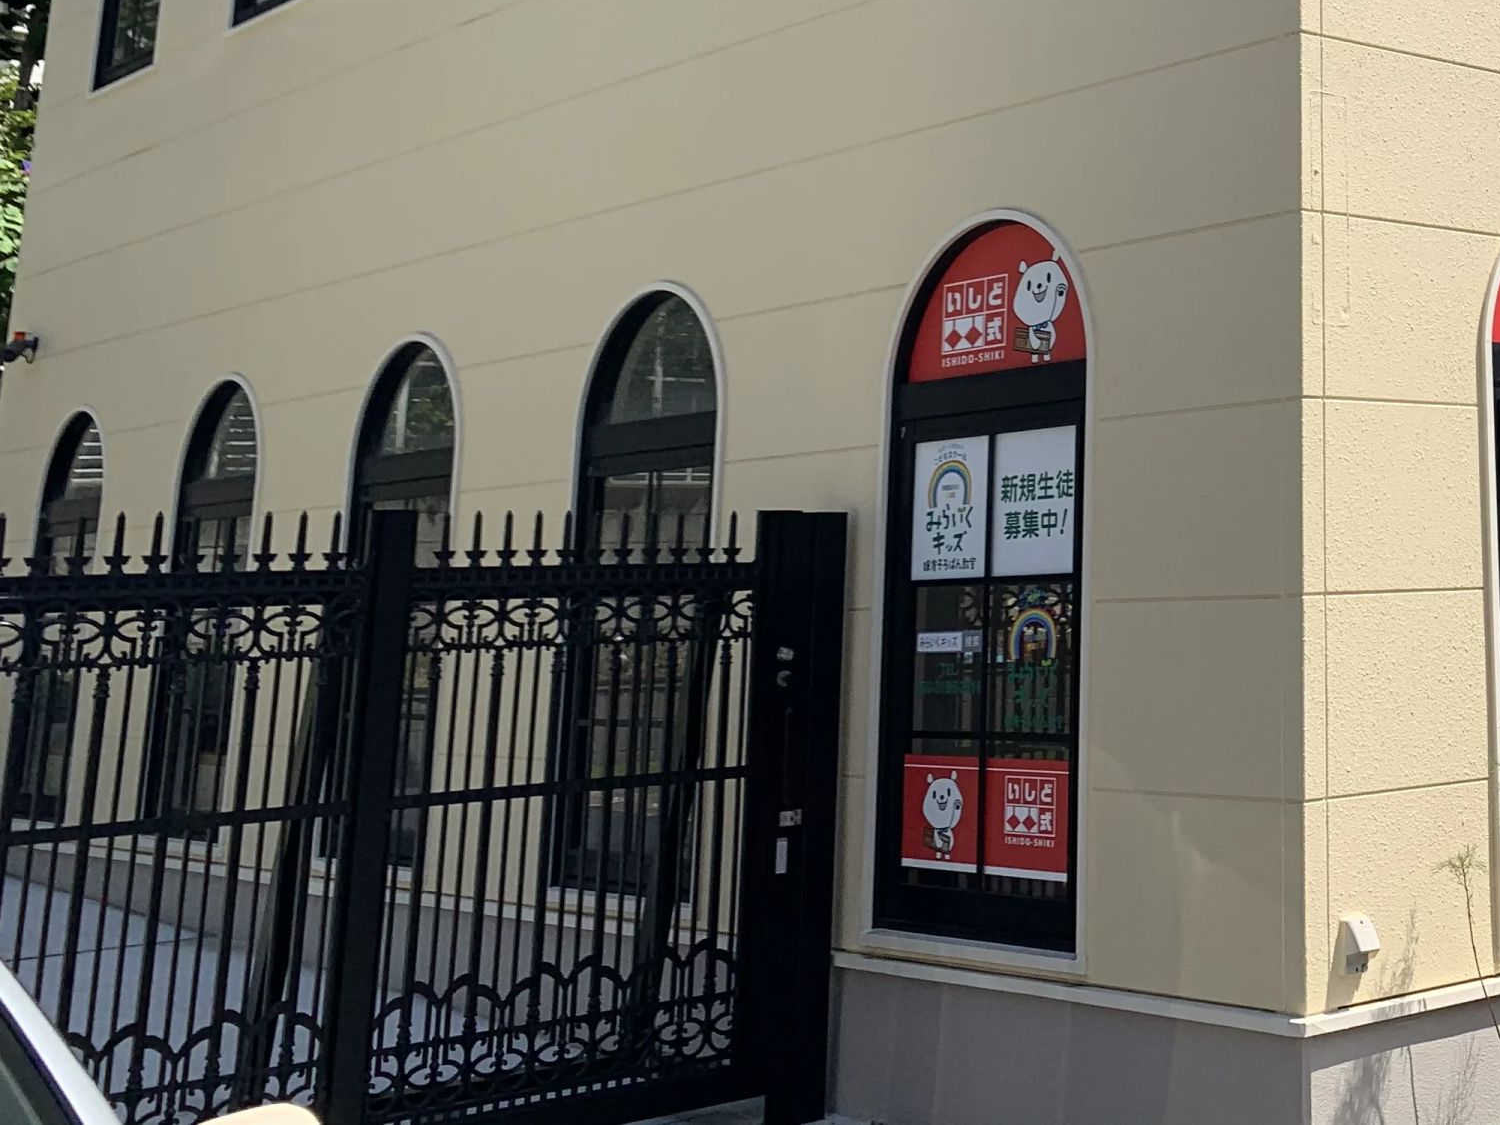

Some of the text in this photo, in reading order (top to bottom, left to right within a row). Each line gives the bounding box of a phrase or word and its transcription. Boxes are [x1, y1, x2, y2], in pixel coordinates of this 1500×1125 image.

[946, 281, 1003, 314] いしど
[941, 351, 1005, 368] ISHIDO-SHIKI
[1001, 470, 1074, 503] 新規生徒
[927, 504, 974, 531] みらいく
[1004, 509, 1068, 540] 募集中!
[932, 531, 967, 555] キッズ
[1008, 782, 1053, 802] いしど
[1005, 837, 1055, 847] ISHIDO-SHIKI
